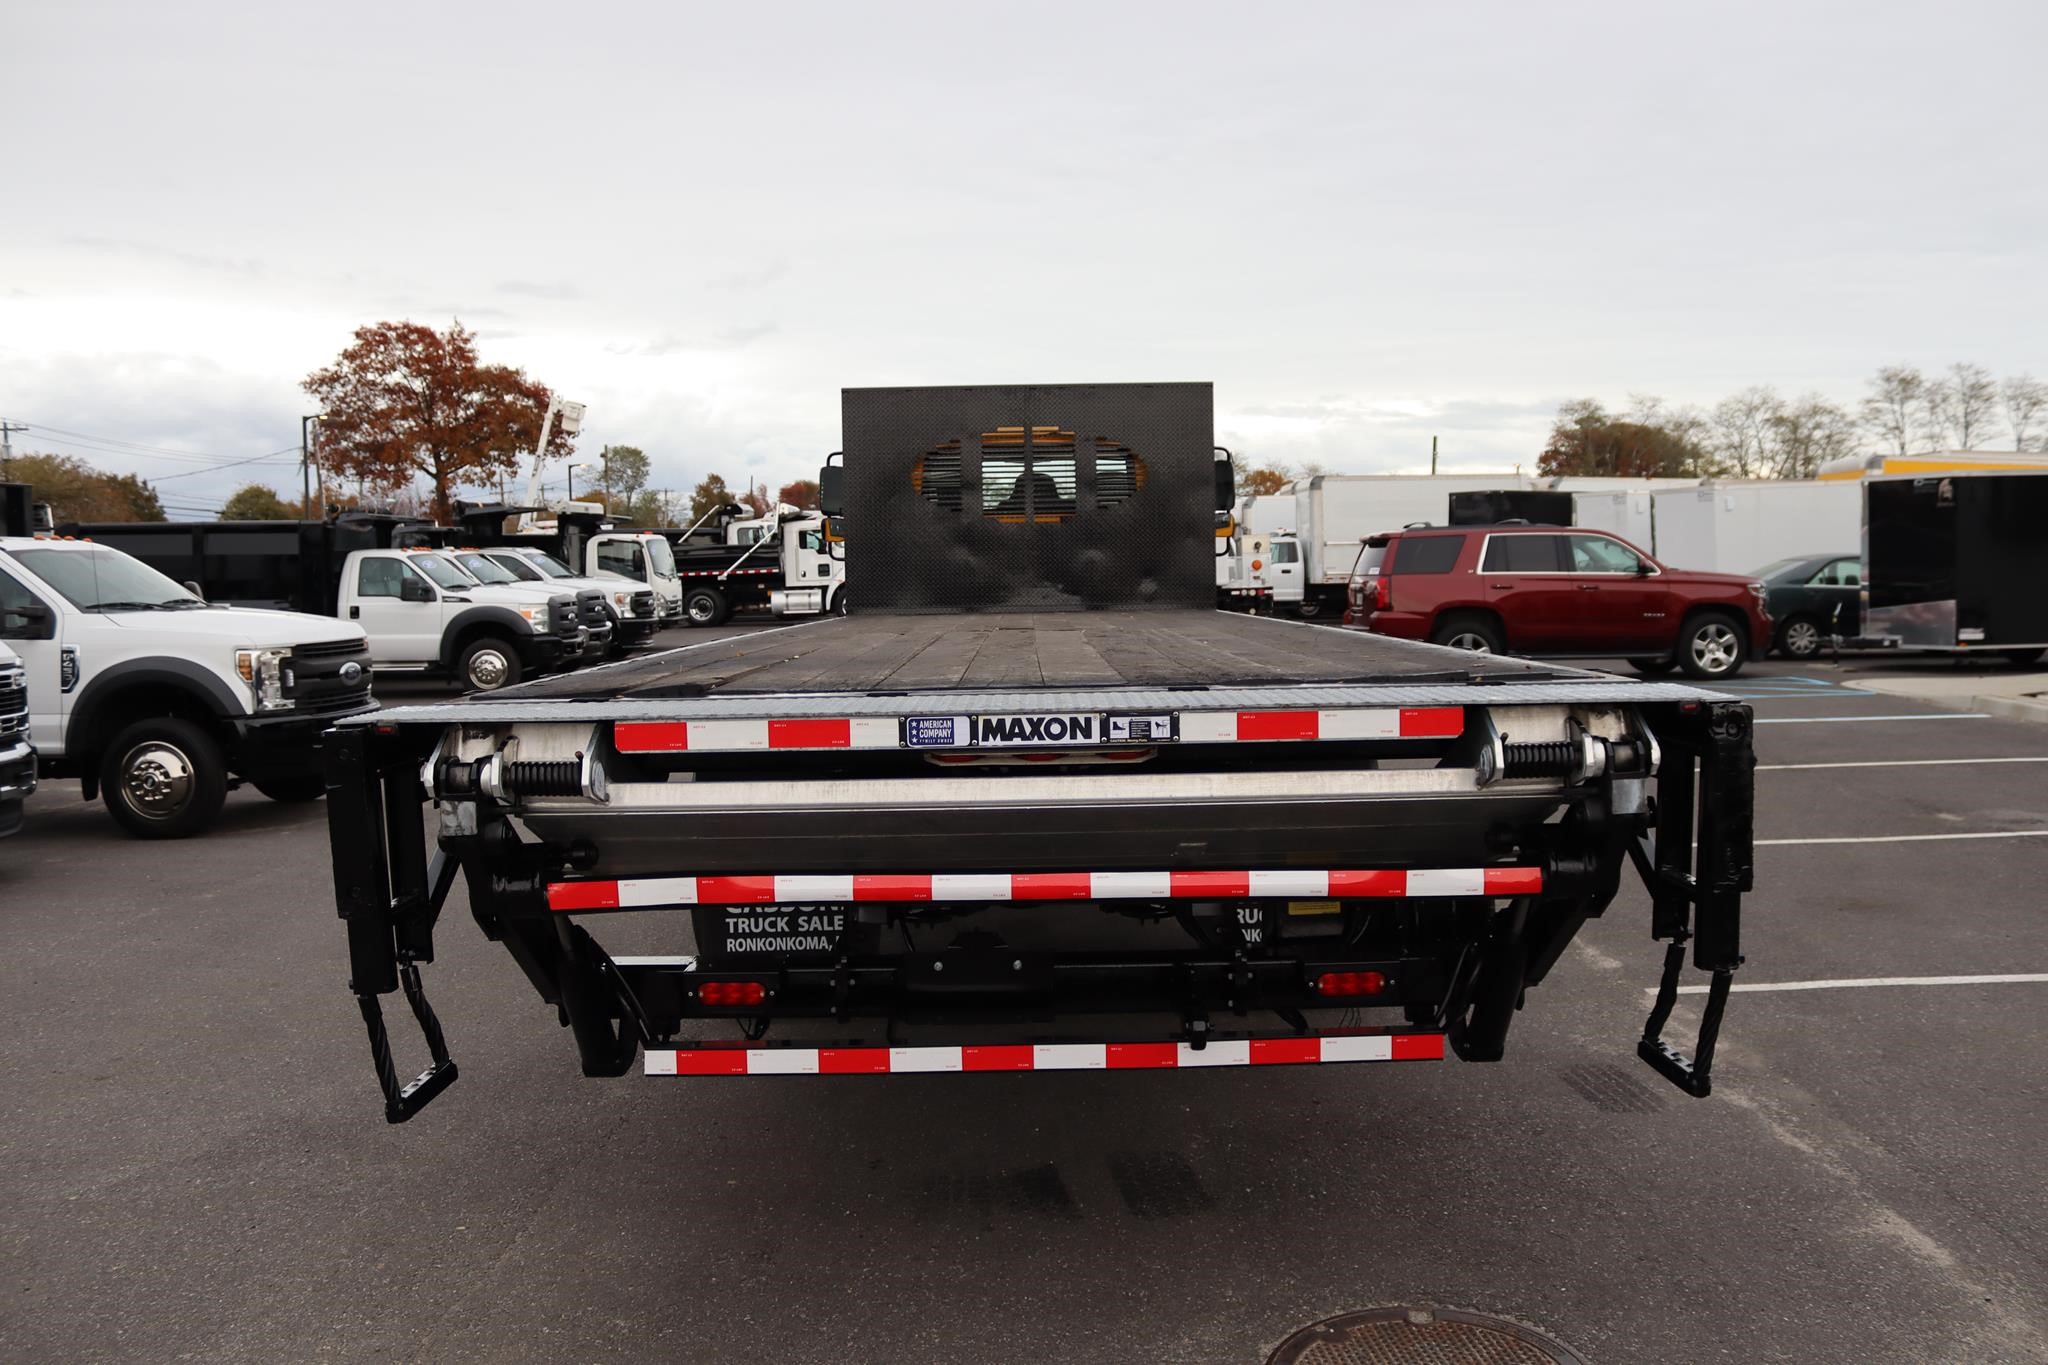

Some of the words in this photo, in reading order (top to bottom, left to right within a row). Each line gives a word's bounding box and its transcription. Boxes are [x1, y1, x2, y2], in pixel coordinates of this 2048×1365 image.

[919, 720, 952, 729] AMERICAN
[919, 728, 952, 738] COMPANY
[981, 716, 1093, 742] MAXON
[725, 917, 790, 934] TRUCK
[726, 936, 832, 953] RONKONKOMA,
